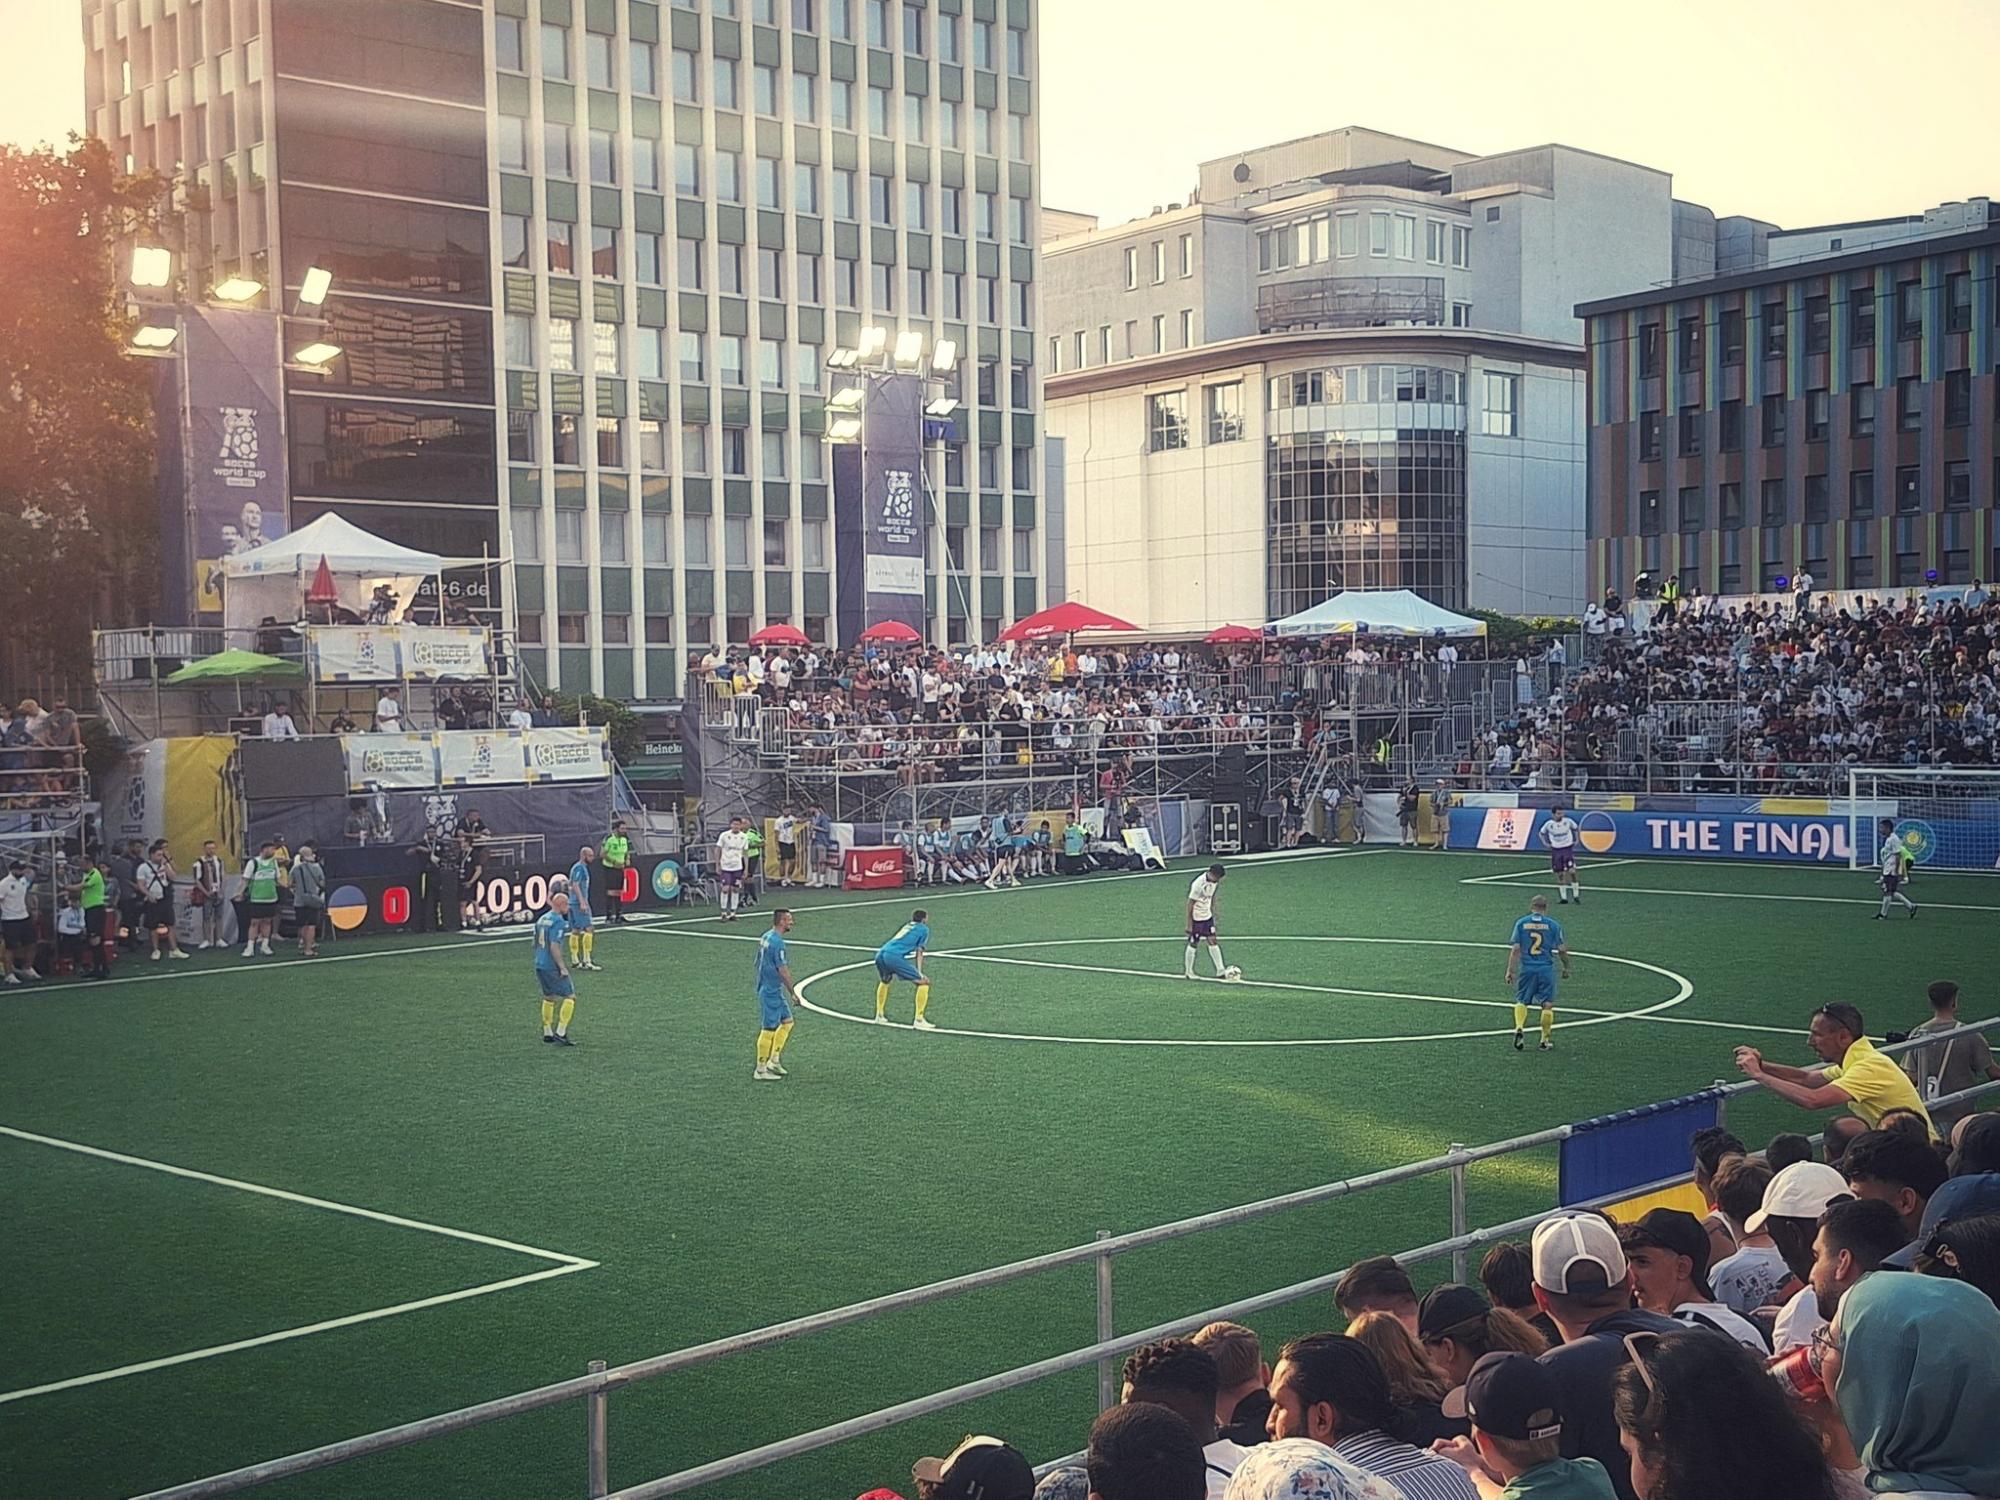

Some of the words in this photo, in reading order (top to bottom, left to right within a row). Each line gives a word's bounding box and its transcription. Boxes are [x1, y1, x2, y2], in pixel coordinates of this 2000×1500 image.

[1646, 819, 1721, 851] THE
[1733, 821, 1855, 861] FINAL
[1529, 931, 1543, 955] 2
